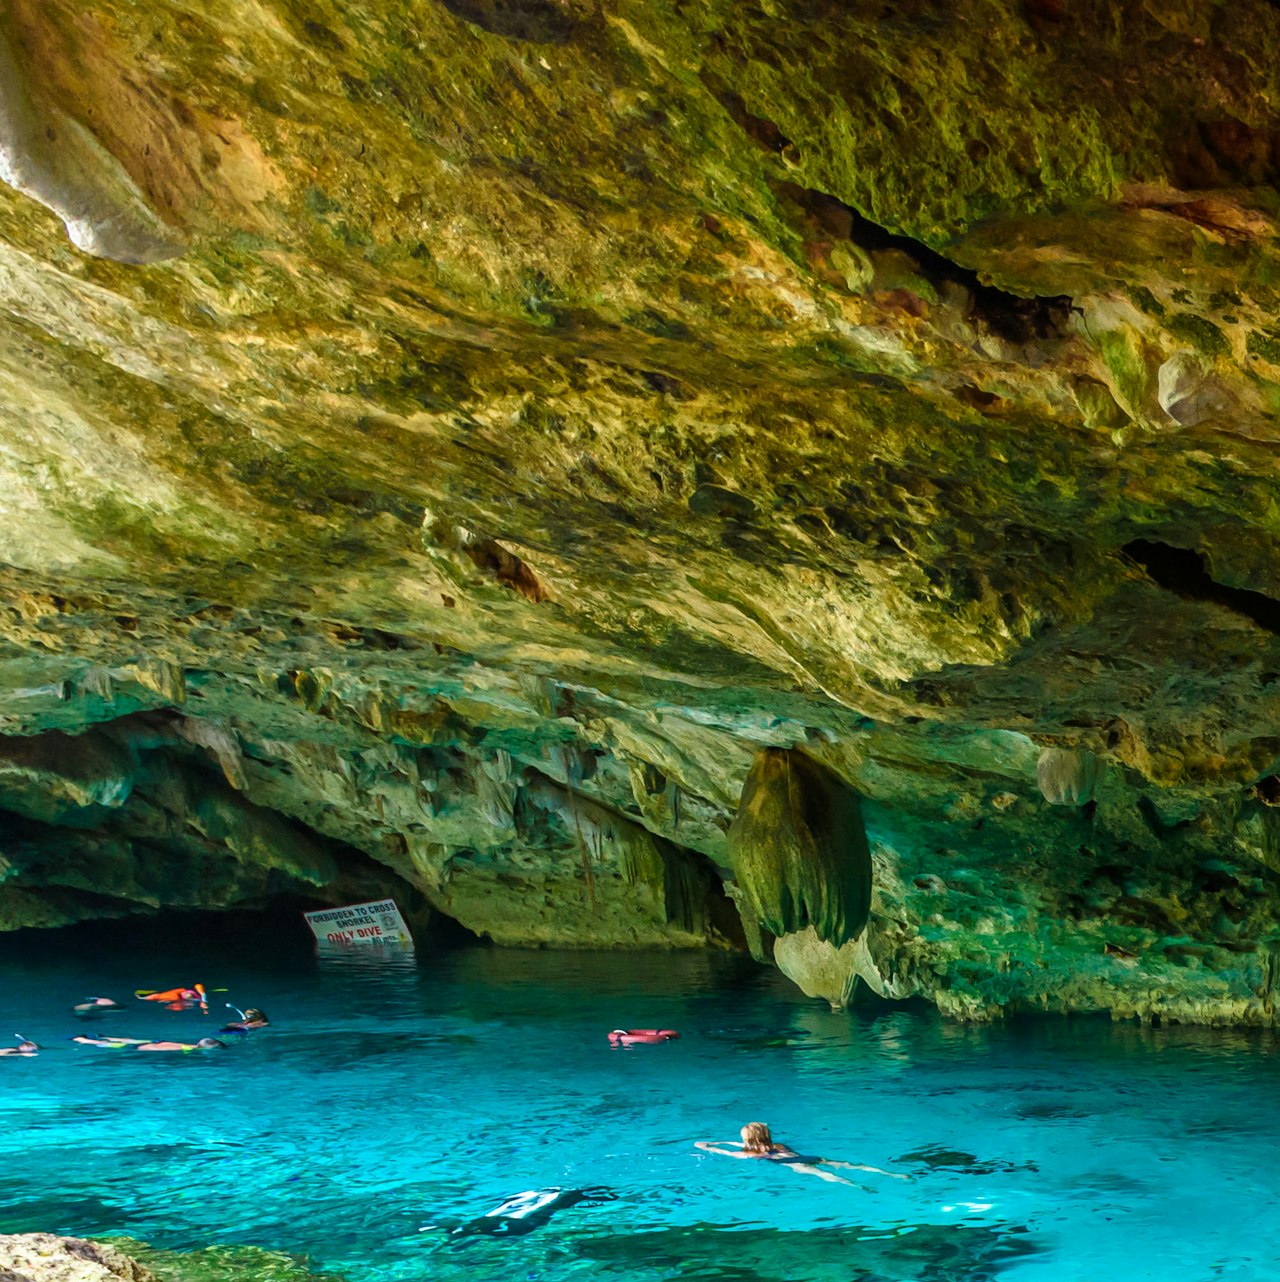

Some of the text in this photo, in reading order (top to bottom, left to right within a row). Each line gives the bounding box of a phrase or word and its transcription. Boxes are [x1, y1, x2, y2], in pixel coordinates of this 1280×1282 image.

[308, 902, 396, 924] FORBIDDEN TO CROSS
[336, 916, 376, 928] SNORKEL
[327, 926, 382, 943] ONLY DIVE
